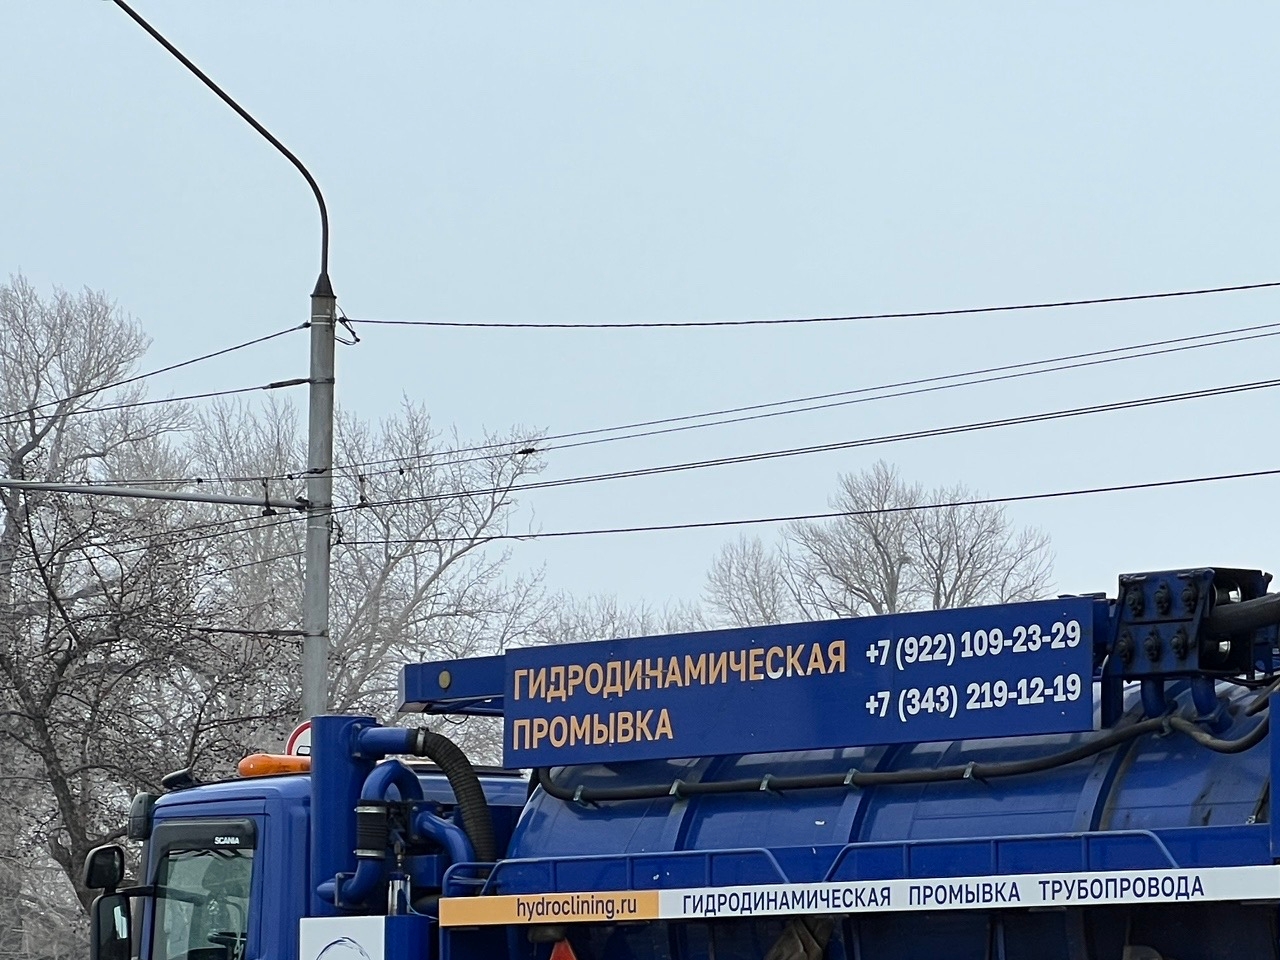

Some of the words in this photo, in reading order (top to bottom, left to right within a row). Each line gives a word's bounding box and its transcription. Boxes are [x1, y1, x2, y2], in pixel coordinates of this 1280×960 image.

[866, 640, 890, 665] +7
[896, 633, 955, 670] (922)
[961, 620, 1081, 657] 109-23-29
[514, 640, 846, 702] ГИДРОДИНАМИЧЕСКАЯ
[866, 691, 890, 717] +7
[898, 685, 958, 722] (343)
[966, 673, 1081, 710] 219-12-19
[513, 708, 674, 750] ПРОМЫВКА
[214, 836, 240, 845] SCANIA
[516, 895, 637, 921] hydroclining.ru
[683, 887, 891, 916] ГИДРОДИНАМИЧЕСКАЯ
[909, 881, 1020, 906] ПРОМЫВКА
[1038, 876, 1205, 901] ТРУБОПРОВОДА
